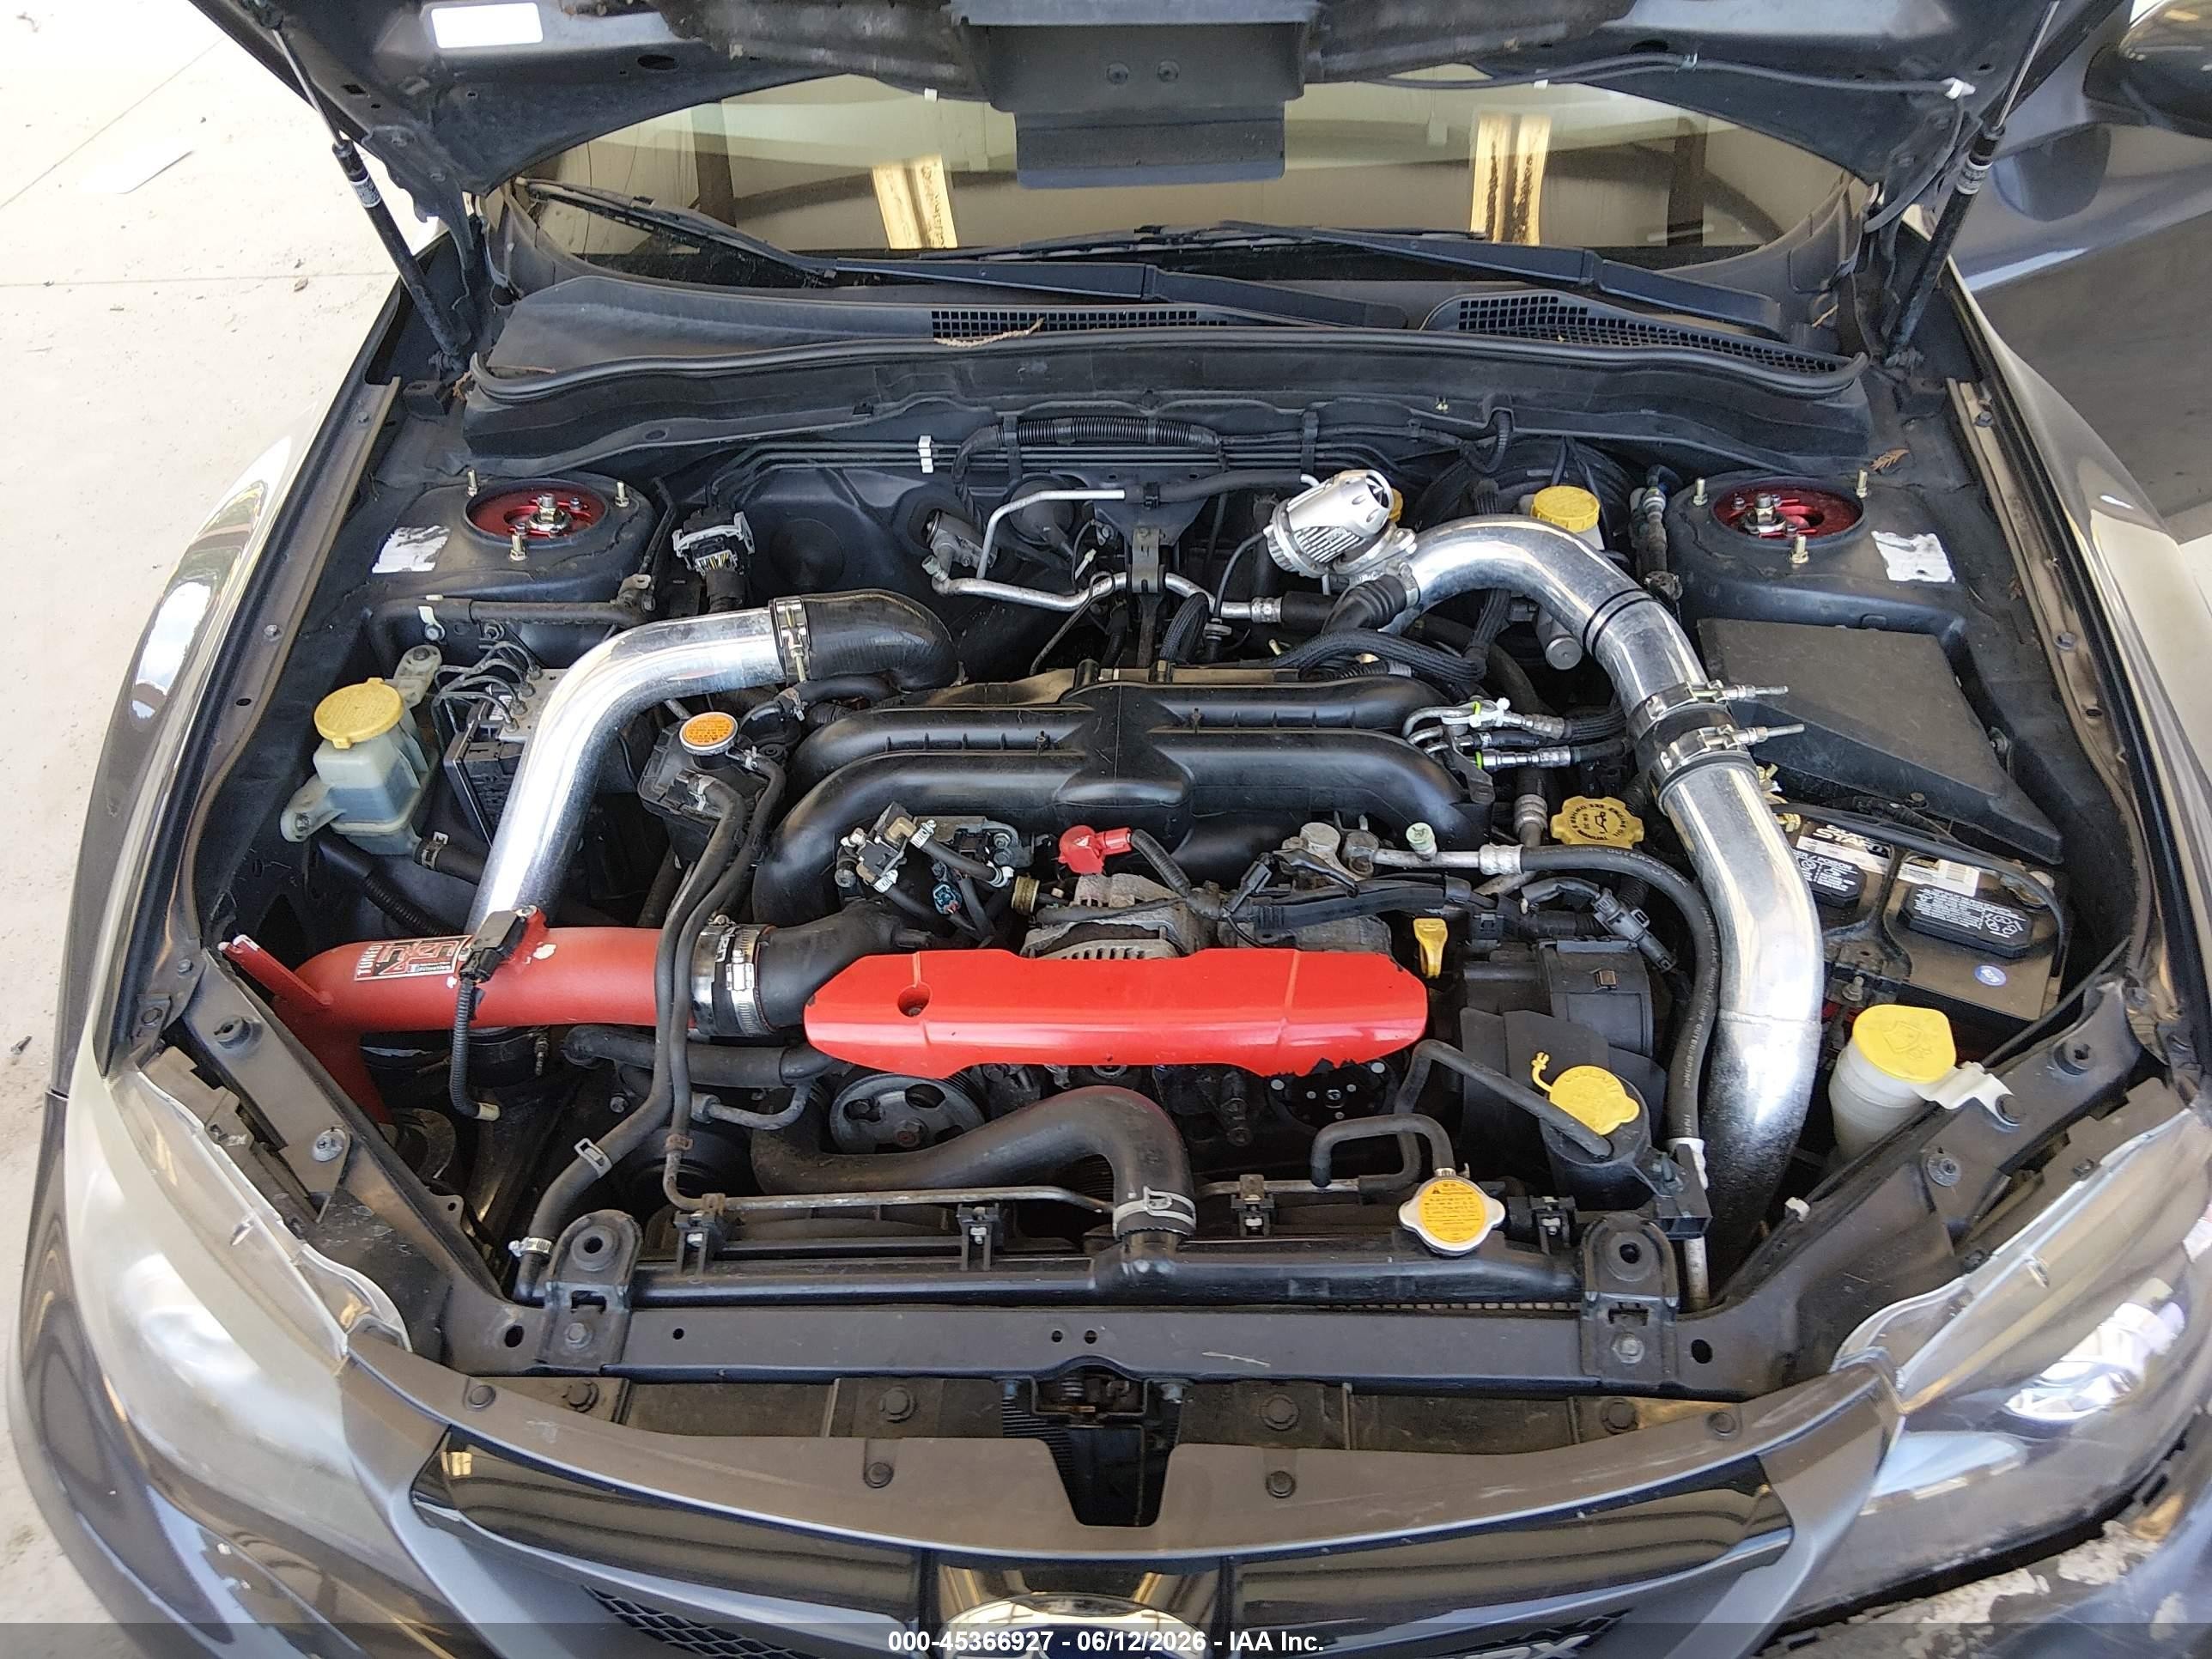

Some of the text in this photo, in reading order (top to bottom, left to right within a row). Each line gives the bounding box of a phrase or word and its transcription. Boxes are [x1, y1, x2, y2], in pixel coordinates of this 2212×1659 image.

[1607, 807, 1627, 838] ENGINE OIL
[1817, 856, 1853, 871] POISON
[356, 944, 384, 977] TUNED
